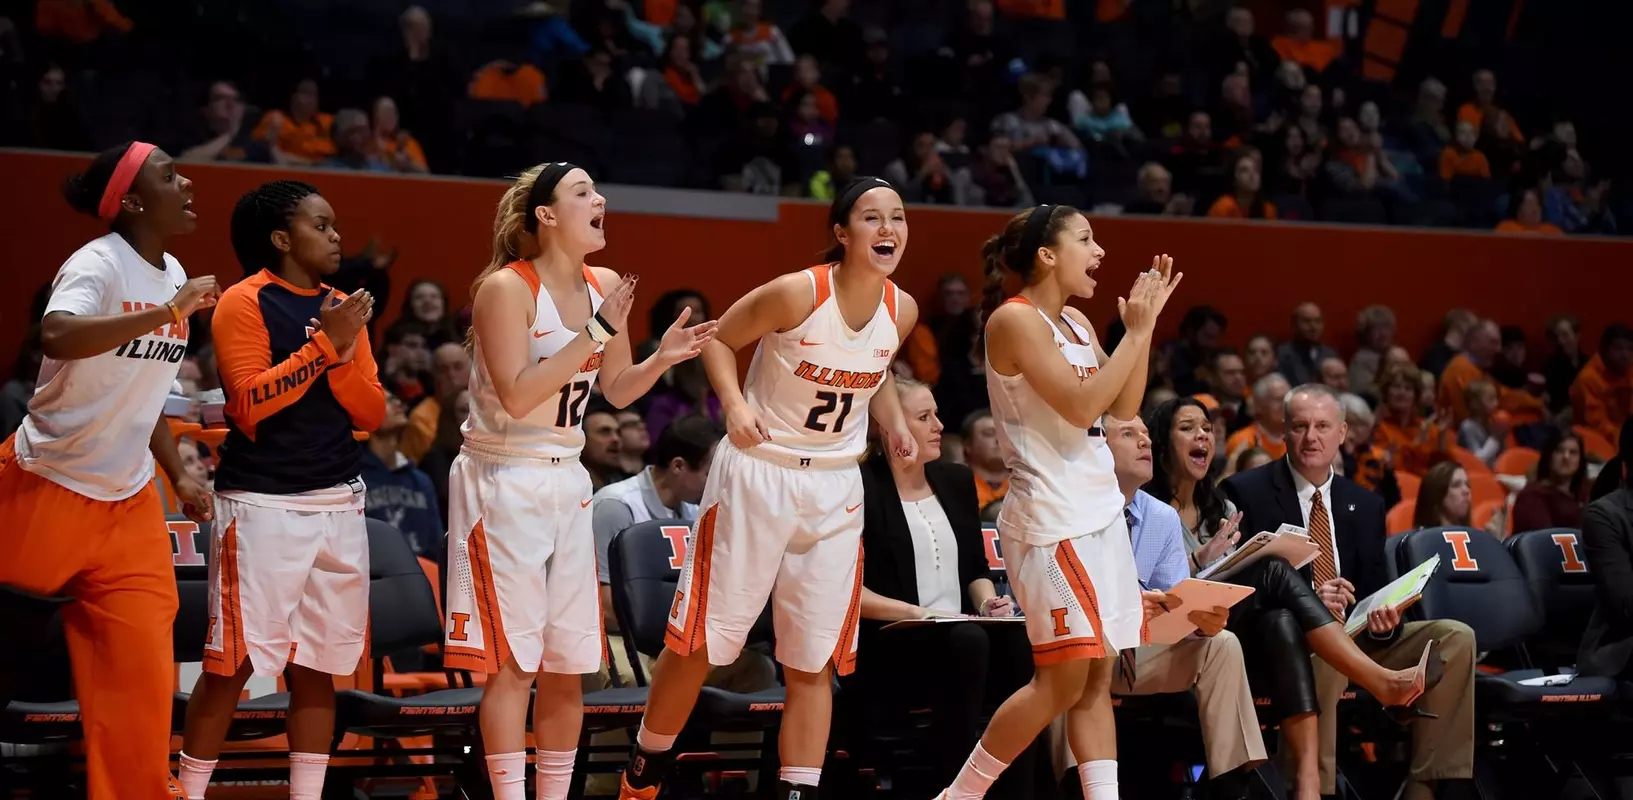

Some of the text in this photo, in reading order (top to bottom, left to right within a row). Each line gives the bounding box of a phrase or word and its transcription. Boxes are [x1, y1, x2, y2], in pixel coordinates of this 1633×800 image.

[248, 354, 326, 405] LLINOIS
[794, 360, 885, 389] ILLINOIS
[555, 380, 590, 428] 12
[803, 390, 854, 433] 21
[1442, 531, 1478, 571] I
[1551, 534, 1587, 573] I
[449, 612, 470, 641] I
[1051, 608, 1070, 636] I
[233, 711, 275, 719] GHTING
